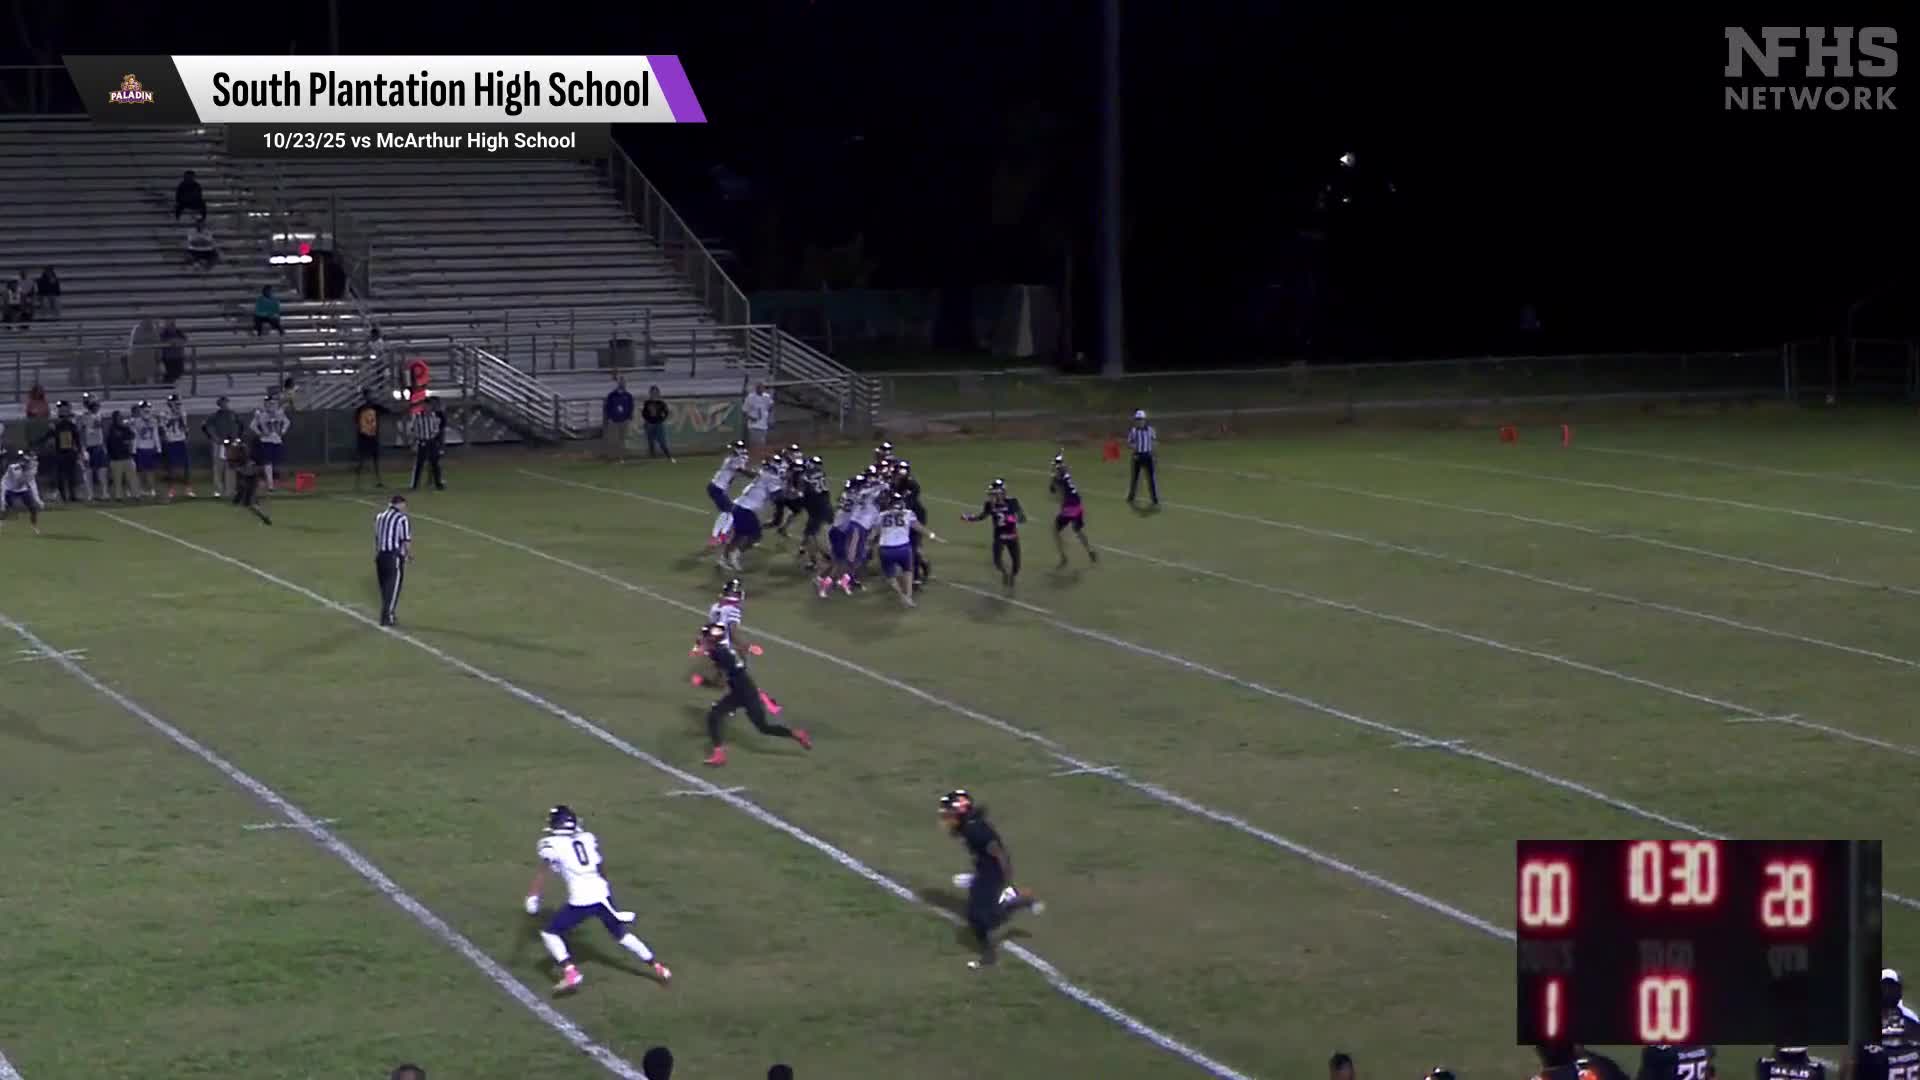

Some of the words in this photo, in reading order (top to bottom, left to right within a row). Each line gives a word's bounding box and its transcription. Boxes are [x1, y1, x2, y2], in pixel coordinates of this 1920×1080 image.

[572, 840, 589, 866] 0
[1521, 862, 1571, 926] 00
[1762, 862, 1813, 927] 28
[1545, 981, 1559, 1037] 1
[1639, 976, 1690, 1041] 00
